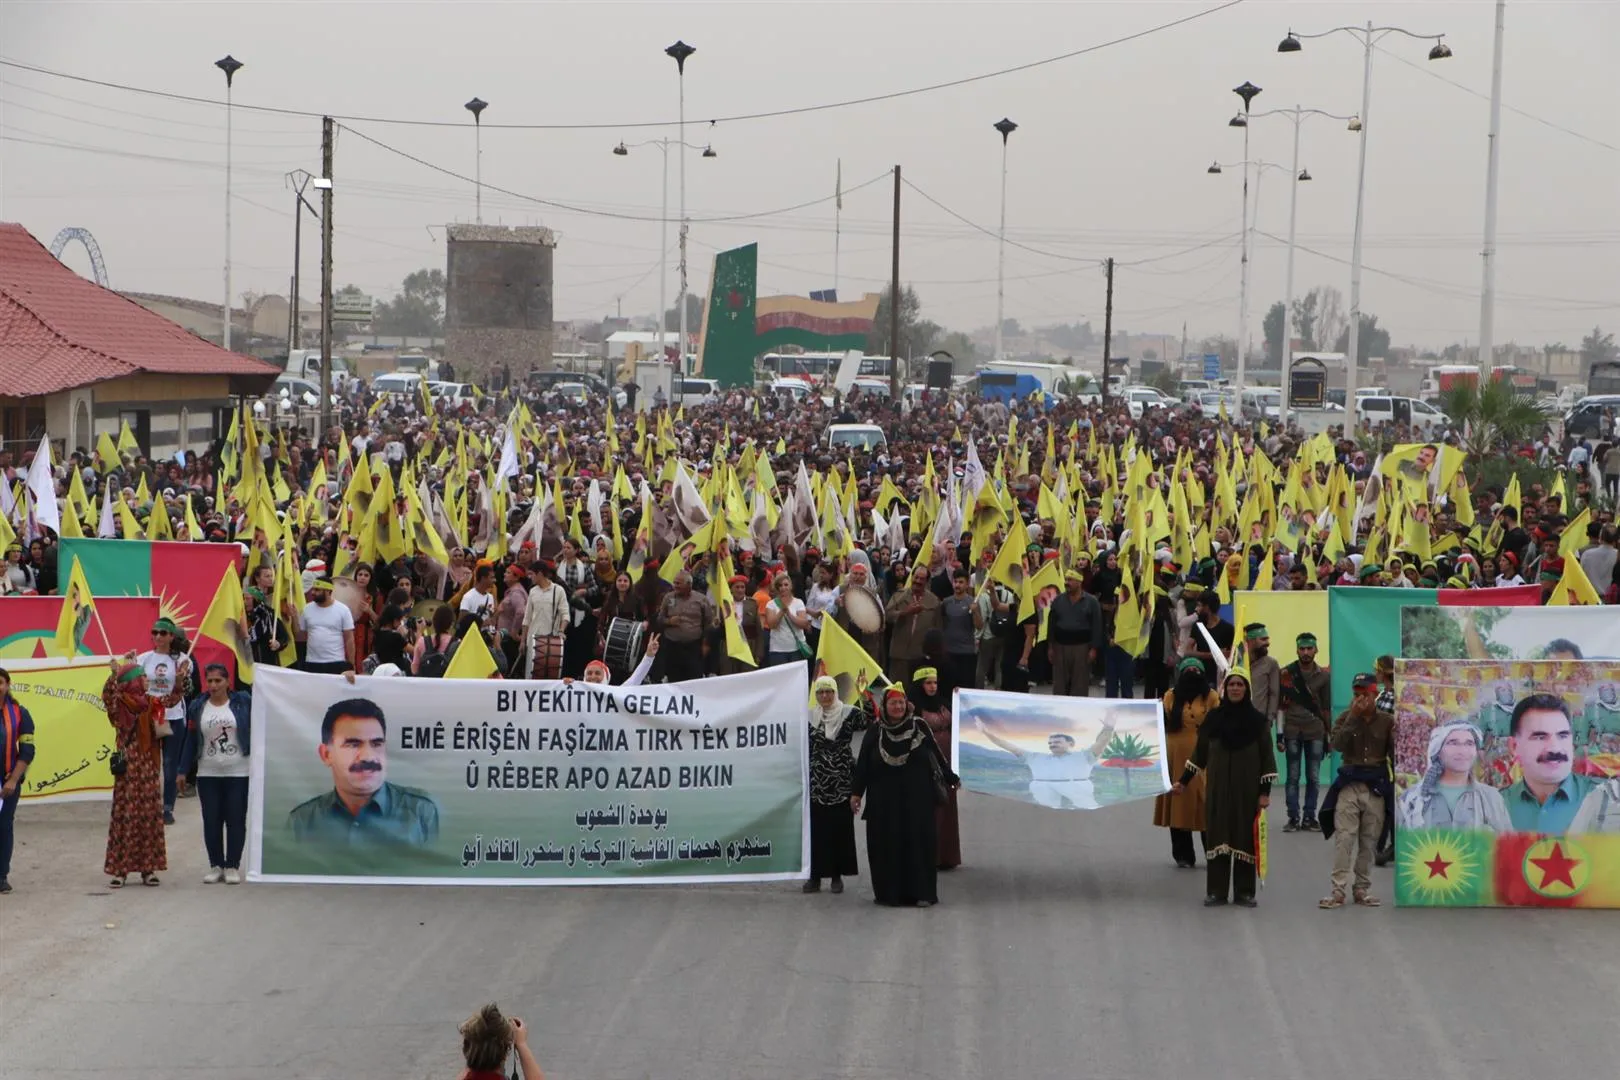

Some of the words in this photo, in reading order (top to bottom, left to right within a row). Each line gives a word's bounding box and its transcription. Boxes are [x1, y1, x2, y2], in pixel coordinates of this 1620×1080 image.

[497, 690, 517, 713] BI
[525, 685, 619, 713] YEKÎTIYA
[624, 694, 700, 718] GELAN,
[401, 721, 445, 750] EMÊ
[453, 721, 530, 756] ÊRÎŞÊN
[538, 722, 629, 757] FAŞÎZMA
[636, 729, 682, 751] TIRK
[689, 724, 729, 750] TÊK
[736, 722, 787, 748] BIBIN
[466, 760, 479, 789] Û
[487, 760, 559, 789] RÊBER
[565, 766, 610, 790] APO
[615, 766, 671, 789] AZAD
[679, 764, 733, 788] BIKIN
[575, 804, 625, 831] الشعوب
[629, 804, 668, 830] بوحدة
[522, 841, 564, 866] سنحرر
[579, 839, 626, 866] التركية
[678, 838, 722, 864] هجمات
[726, 836, 772, 865] سنهزم
